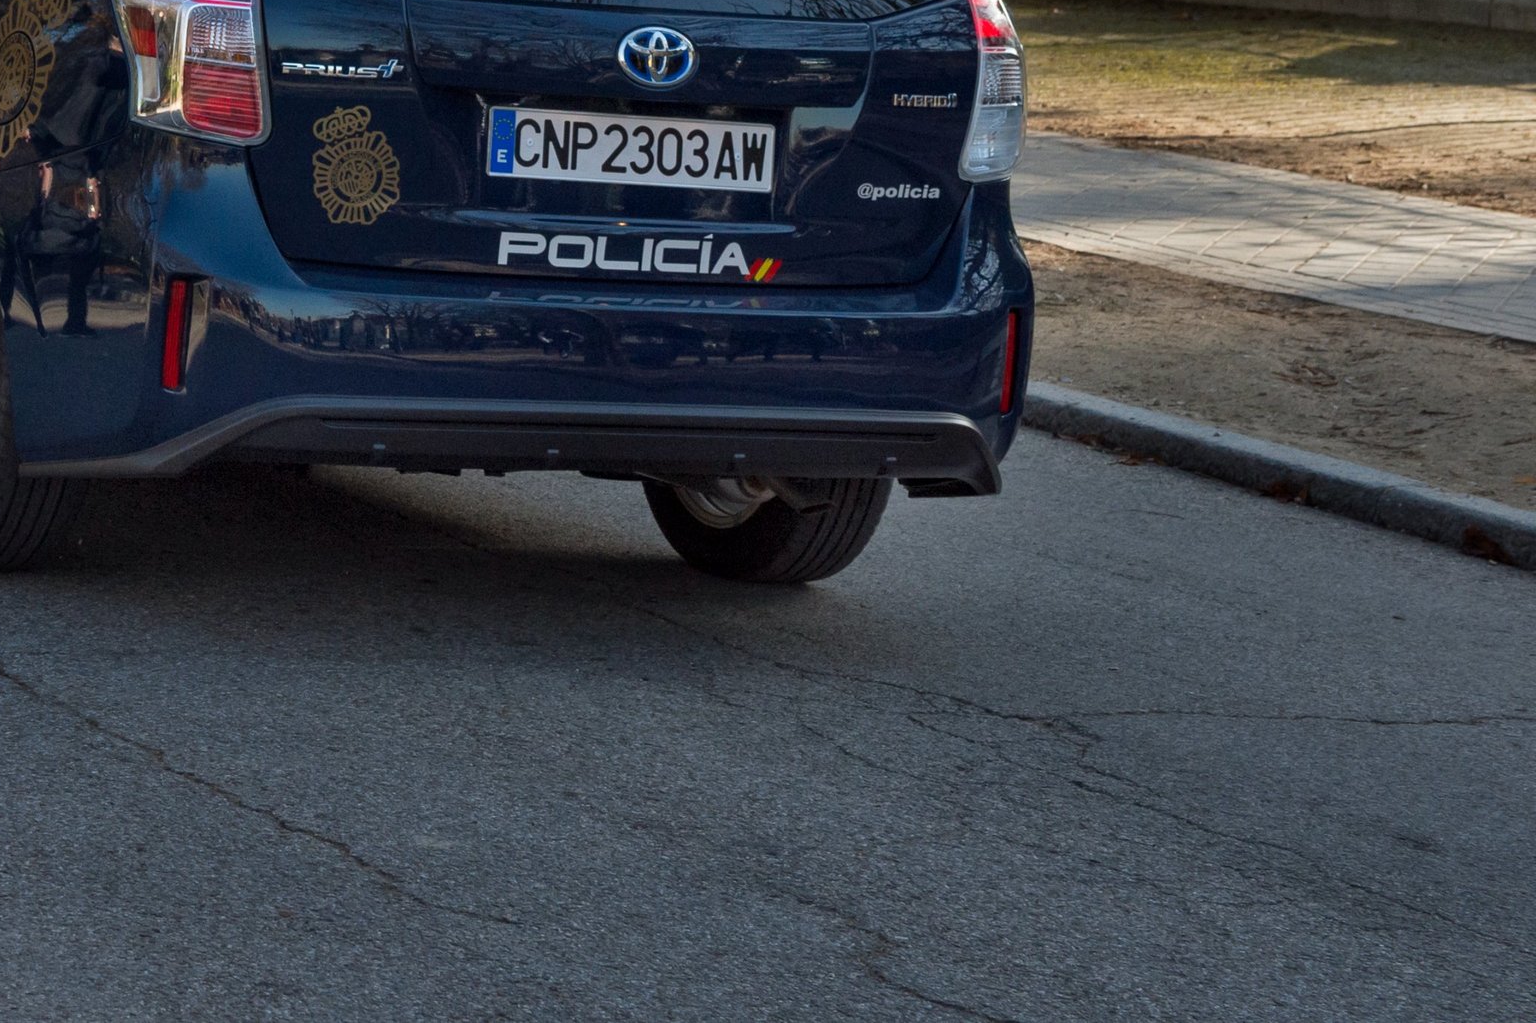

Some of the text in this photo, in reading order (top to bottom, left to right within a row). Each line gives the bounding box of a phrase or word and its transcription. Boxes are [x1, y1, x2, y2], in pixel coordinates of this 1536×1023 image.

[893, 93, 949, 108] HYBRID
[496, 149, 507, 163] E
[857, 183, 941, 202] @policia
[497, 232, 751, 275] POLICÍA
